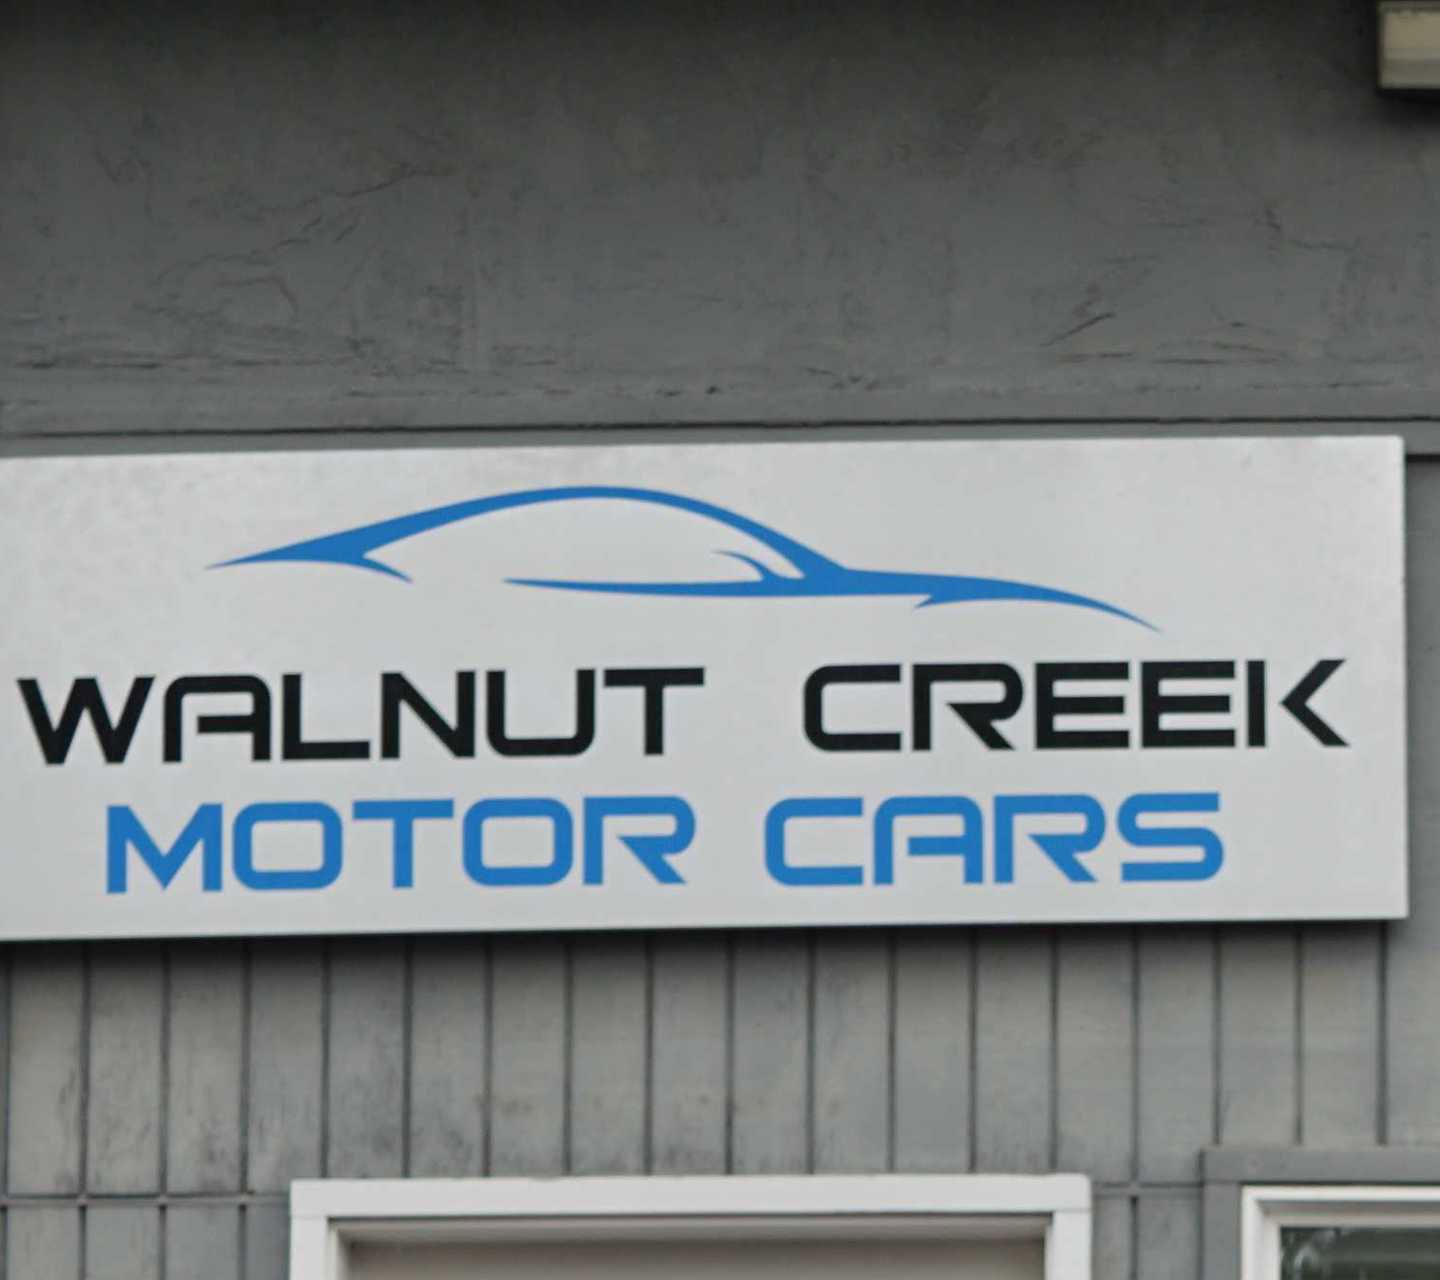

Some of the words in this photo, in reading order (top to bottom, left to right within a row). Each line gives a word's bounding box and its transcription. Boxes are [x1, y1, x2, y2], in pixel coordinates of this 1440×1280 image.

[17, 668, 705, 765] WALNUT
[803, 659, 1348, 753] CREEK
[105, 794, 697, 895] MOTOR
[763, 791, 1225, 888] CARS
